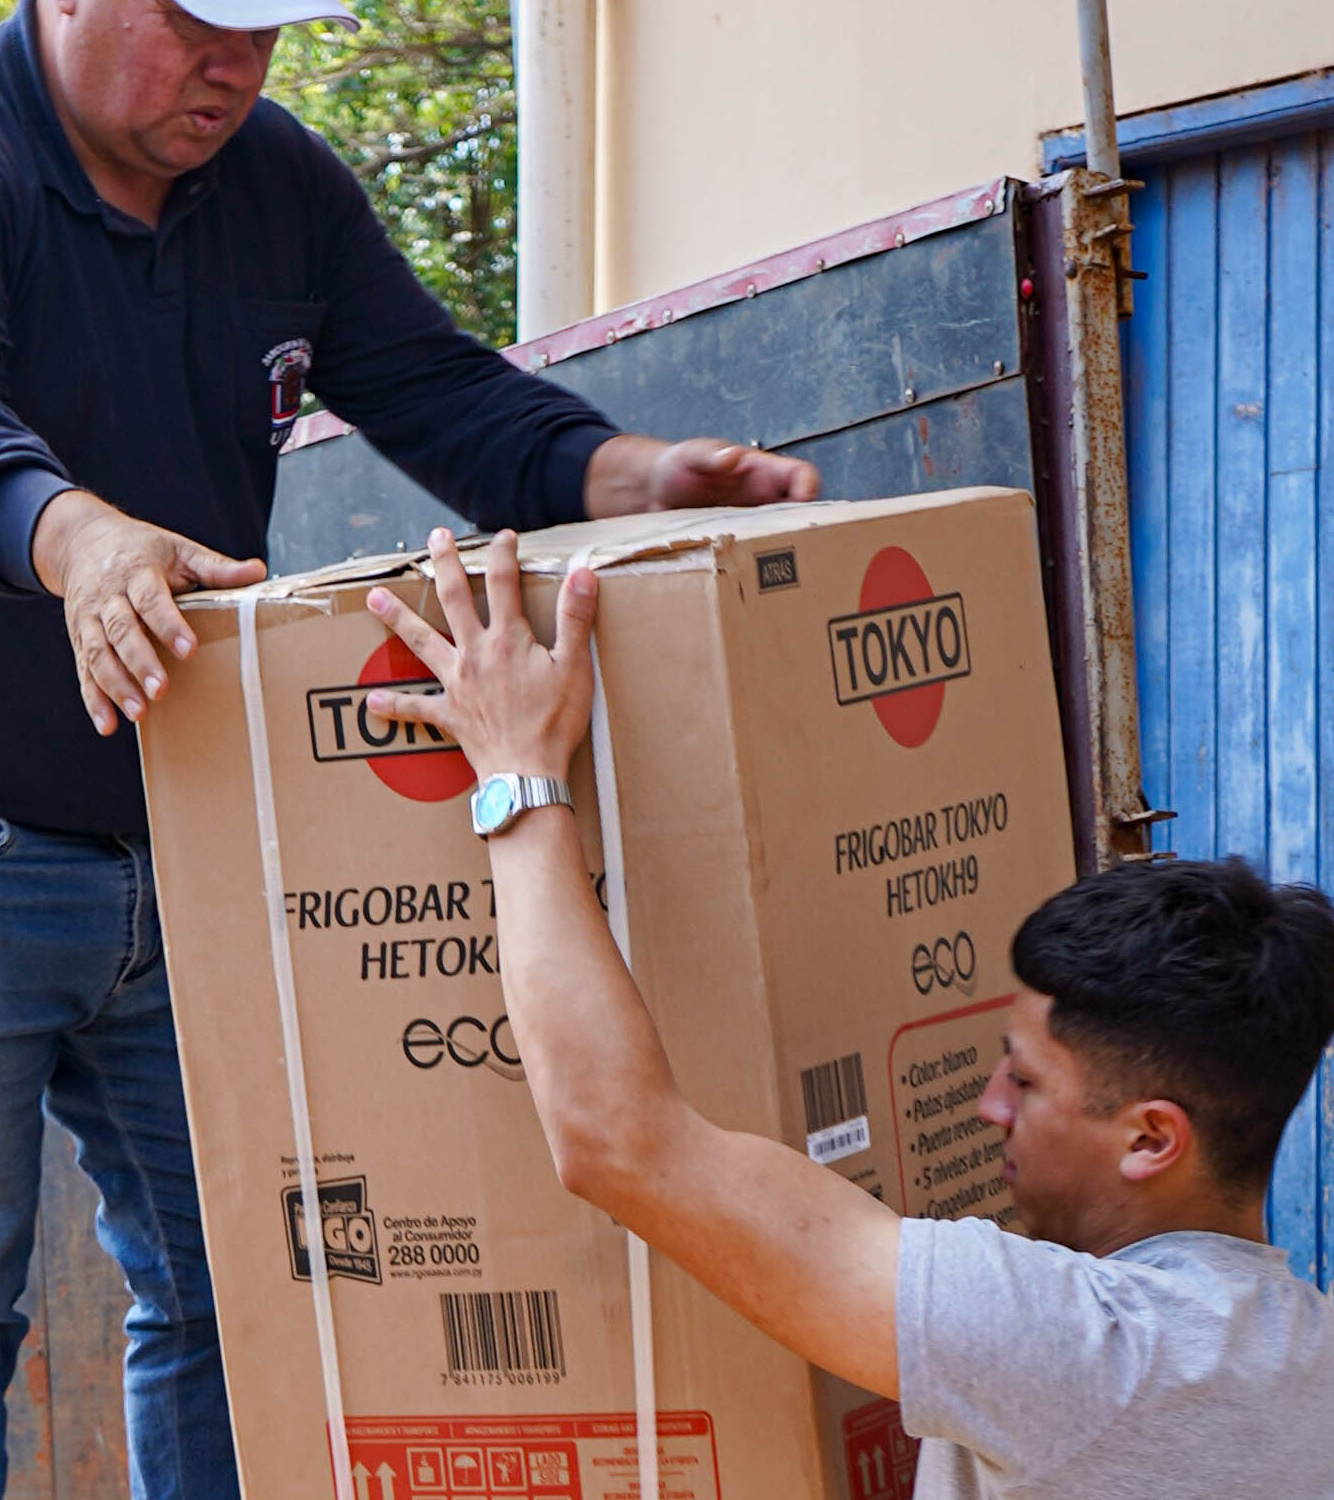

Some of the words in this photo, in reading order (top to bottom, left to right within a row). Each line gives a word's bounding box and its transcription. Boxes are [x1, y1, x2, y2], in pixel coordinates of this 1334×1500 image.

[836, 606, 961, 691] TOKYO
[319, 686, 445, 750] TOK
[835, 811, 938, 875] FRIGOBAR
[941, 793, 1008, 845] TOKYO
[886, 855, 979, 918] HETOKH9
[360, 935, 501, 981] HETOK
[922, 1167, 933, 1190] 5
[297, 1216, 372, 1254] GO
[383, 1216, 421, 1230] Centro
[423, 1217, 438, 1229] de
[441, 1214, 477, 1230] Apoyo
[392, 1231, 403, 1243] al
[405, 1229, 473, 1243] Consumidor
[389, 1245, 426, 1266] 288
[430, 1243, 480, 1265] 0000
